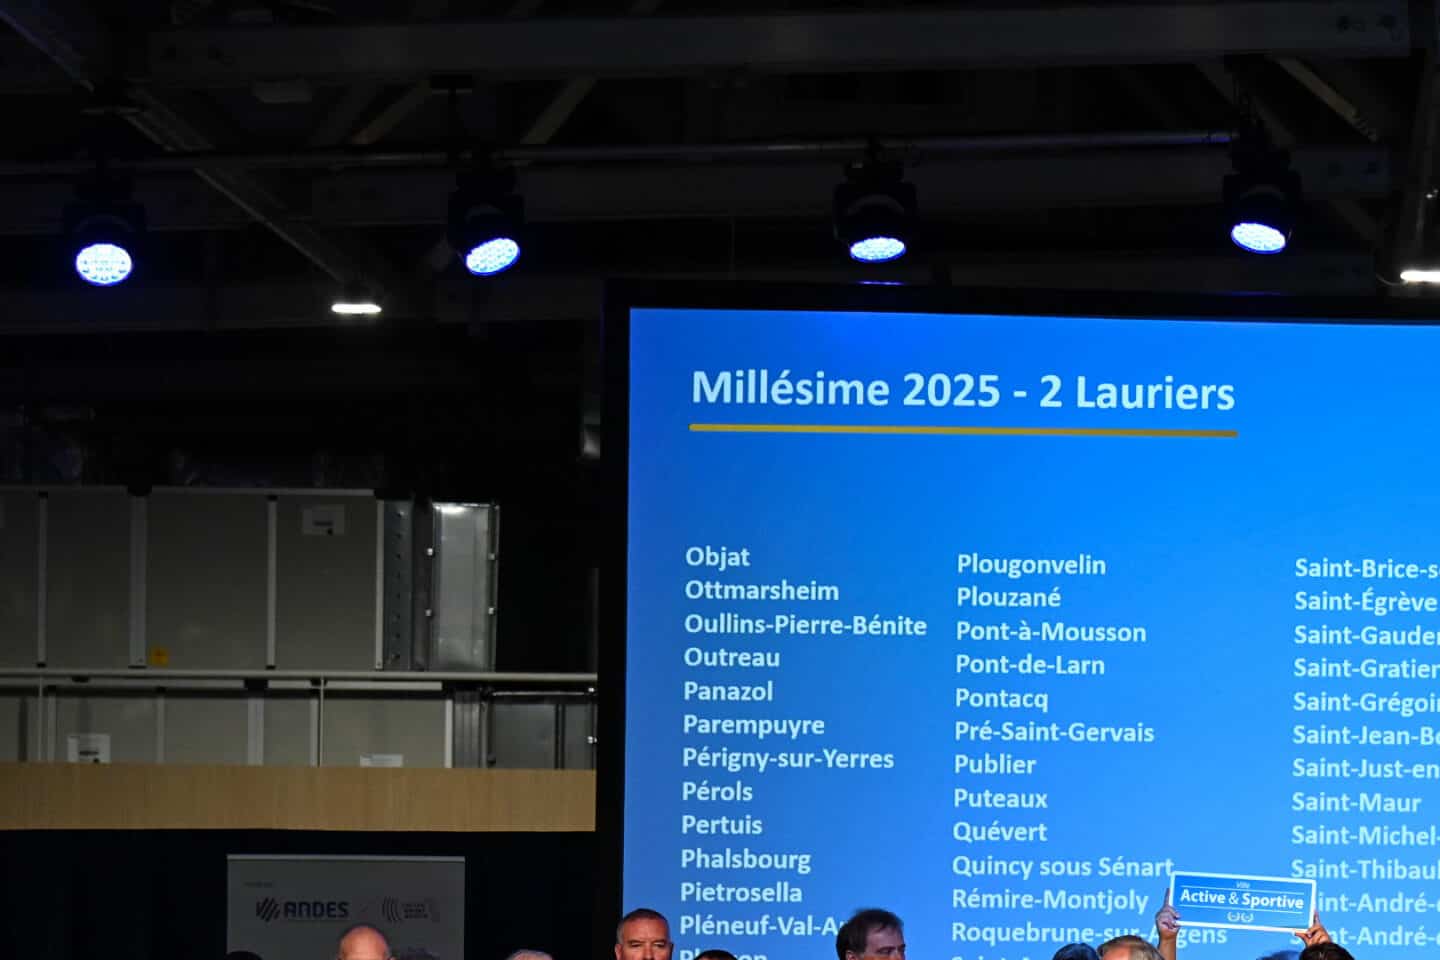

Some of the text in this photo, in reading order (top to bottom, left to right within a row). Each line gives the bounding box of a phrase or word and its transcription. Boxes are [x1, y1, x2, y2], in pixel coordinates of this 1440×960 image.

[693, 369, 1236, 410] Millésime 2025 - 2 Lauriers
[686, 545, 750, 571] Objat
[958, 553, 1106, 579] Plougonvelin
[685, 579, 839, 600] Ottmarsheim
[958, 585, 1061, 607] Plouzané
[1295, 587, 1438, 616] Saint-Égrève
[685, 612, 927, 635] Oullins-Pierre-Bénite
[957, 620, 1146, 642] Pont-à-Mousson
[684, 647, 780, 667] Outreau
[957, 653, 1104, 674] Pont-de-Larn
[684, 680, 773, 701] Panazol
[956, 688, 1048, 713] Pontacq
[684, 714, 824, 739] Parempuyre
[956, 720, 1154, 742] Pré-Saint-Gervais
[683, 746, 894, 772] Périgny-sur-Yerres
[955, 752, 1037, 774] Publier
[683, 780, 752, 801] Pérols
[955, 788, 1047, 808] Puteaux
[1292, 792, 1422, 812] Saint-Maur
[682, 815, 762, 834] Pertuis
[953, 820, 1047, 843] Quévert
[682, 848, 811, 874] Phalsbourg
[953, 855, 1173, 879] Quincy sous Sénart
[681, 881, 802, 902] Pietrosella
[953, 888, 1149, 914] Rémire-Montjoly
[1181, 888, 1304, 911] Active & Sportive
